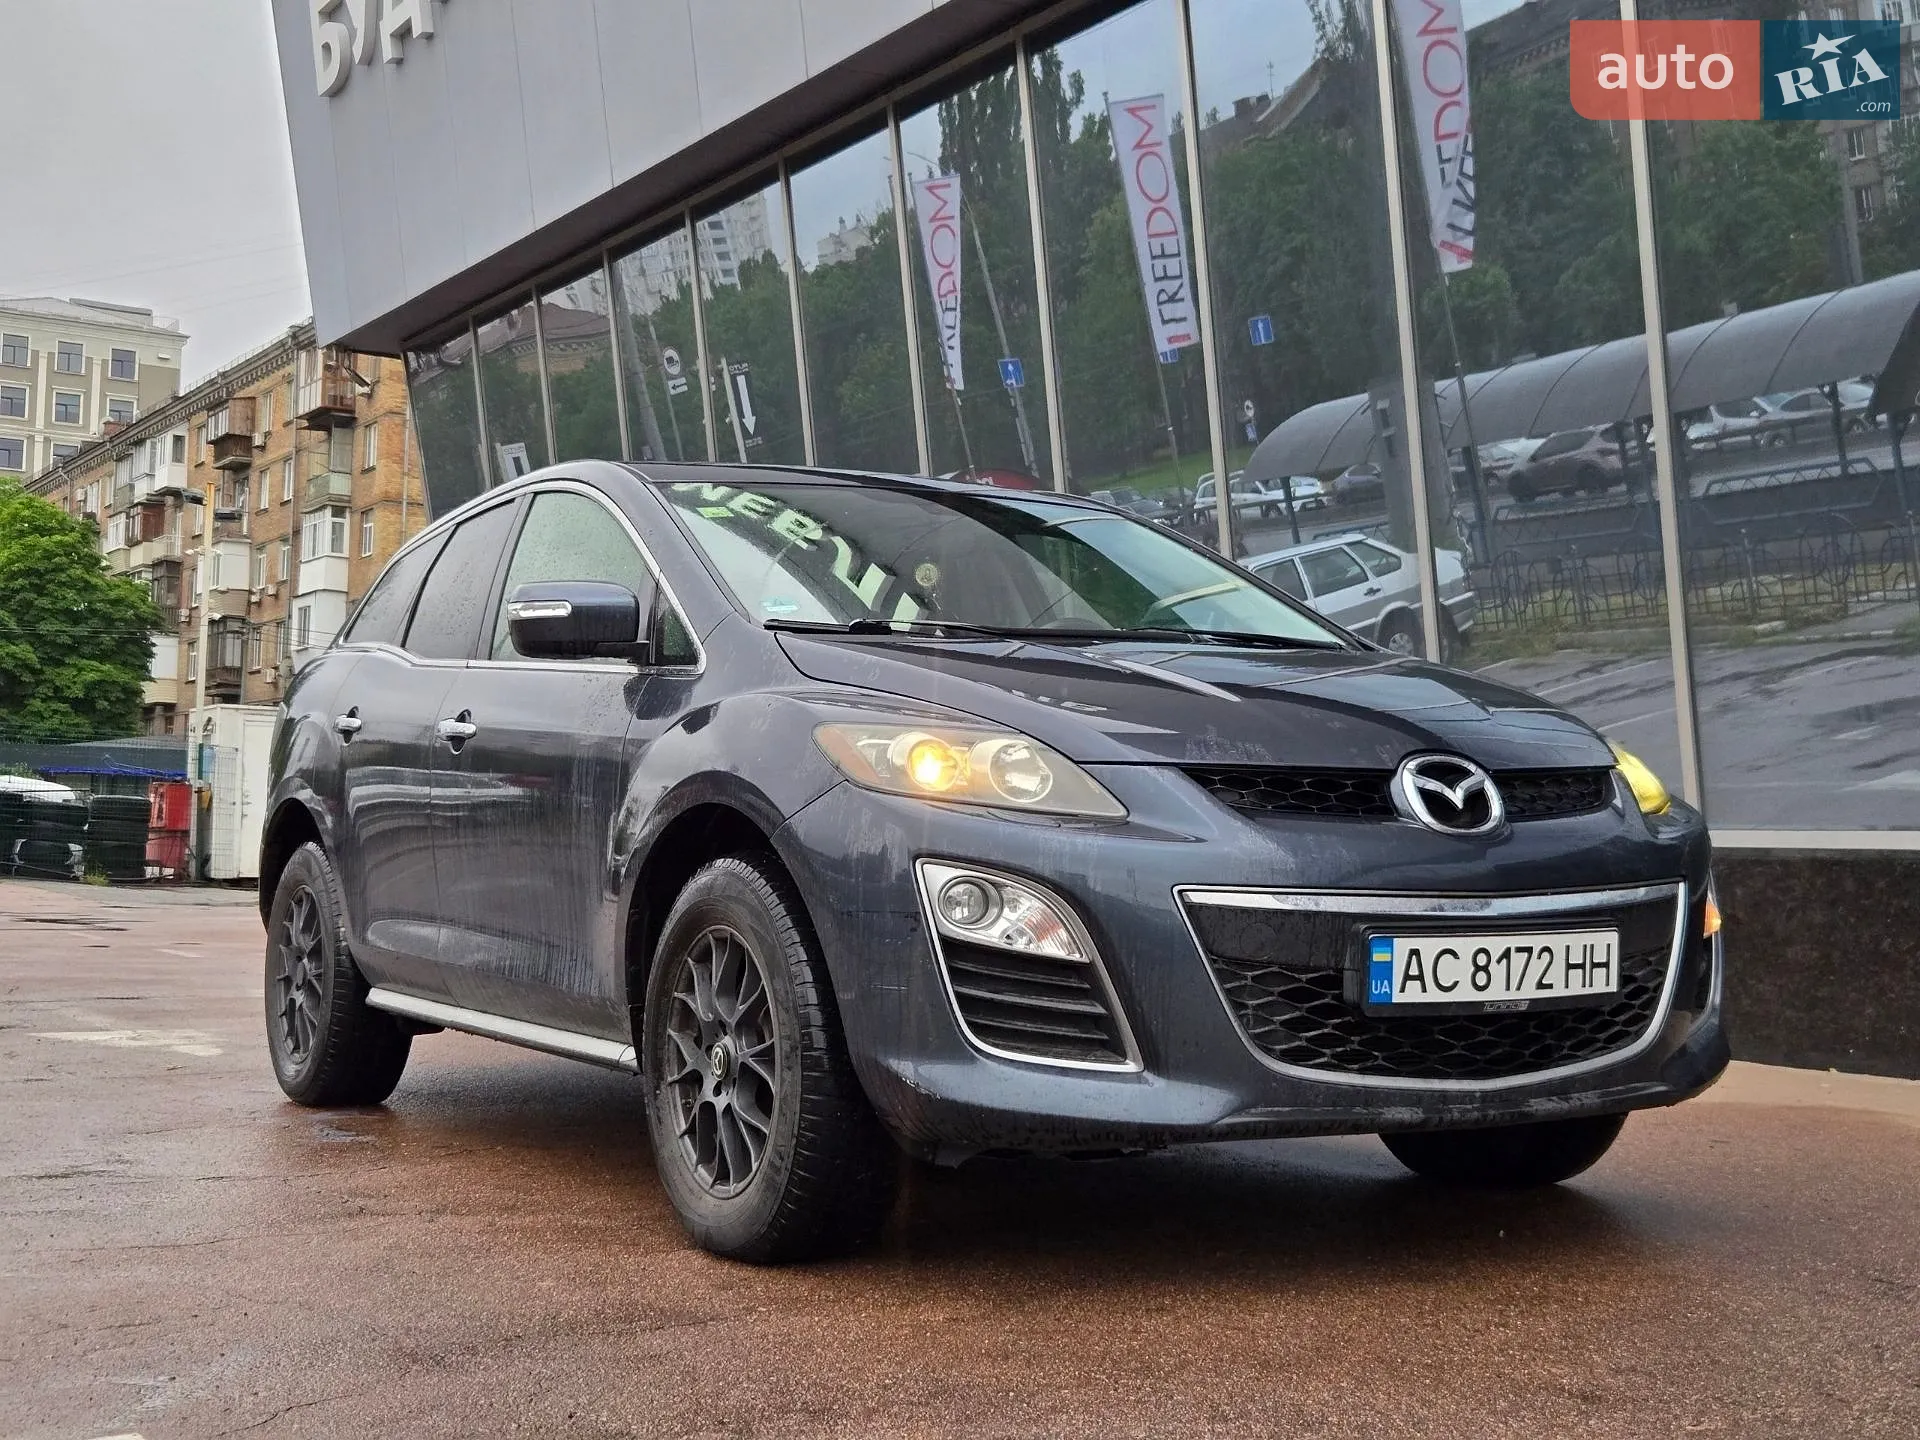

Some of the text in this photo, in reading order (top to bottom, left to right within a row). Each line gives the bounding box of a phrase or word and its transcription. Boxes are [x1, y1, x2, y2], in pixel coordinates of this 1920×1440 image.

[1399, 943, 1611, 995] AC 8172 HH
[1371, 979, 1391, 995] UA
